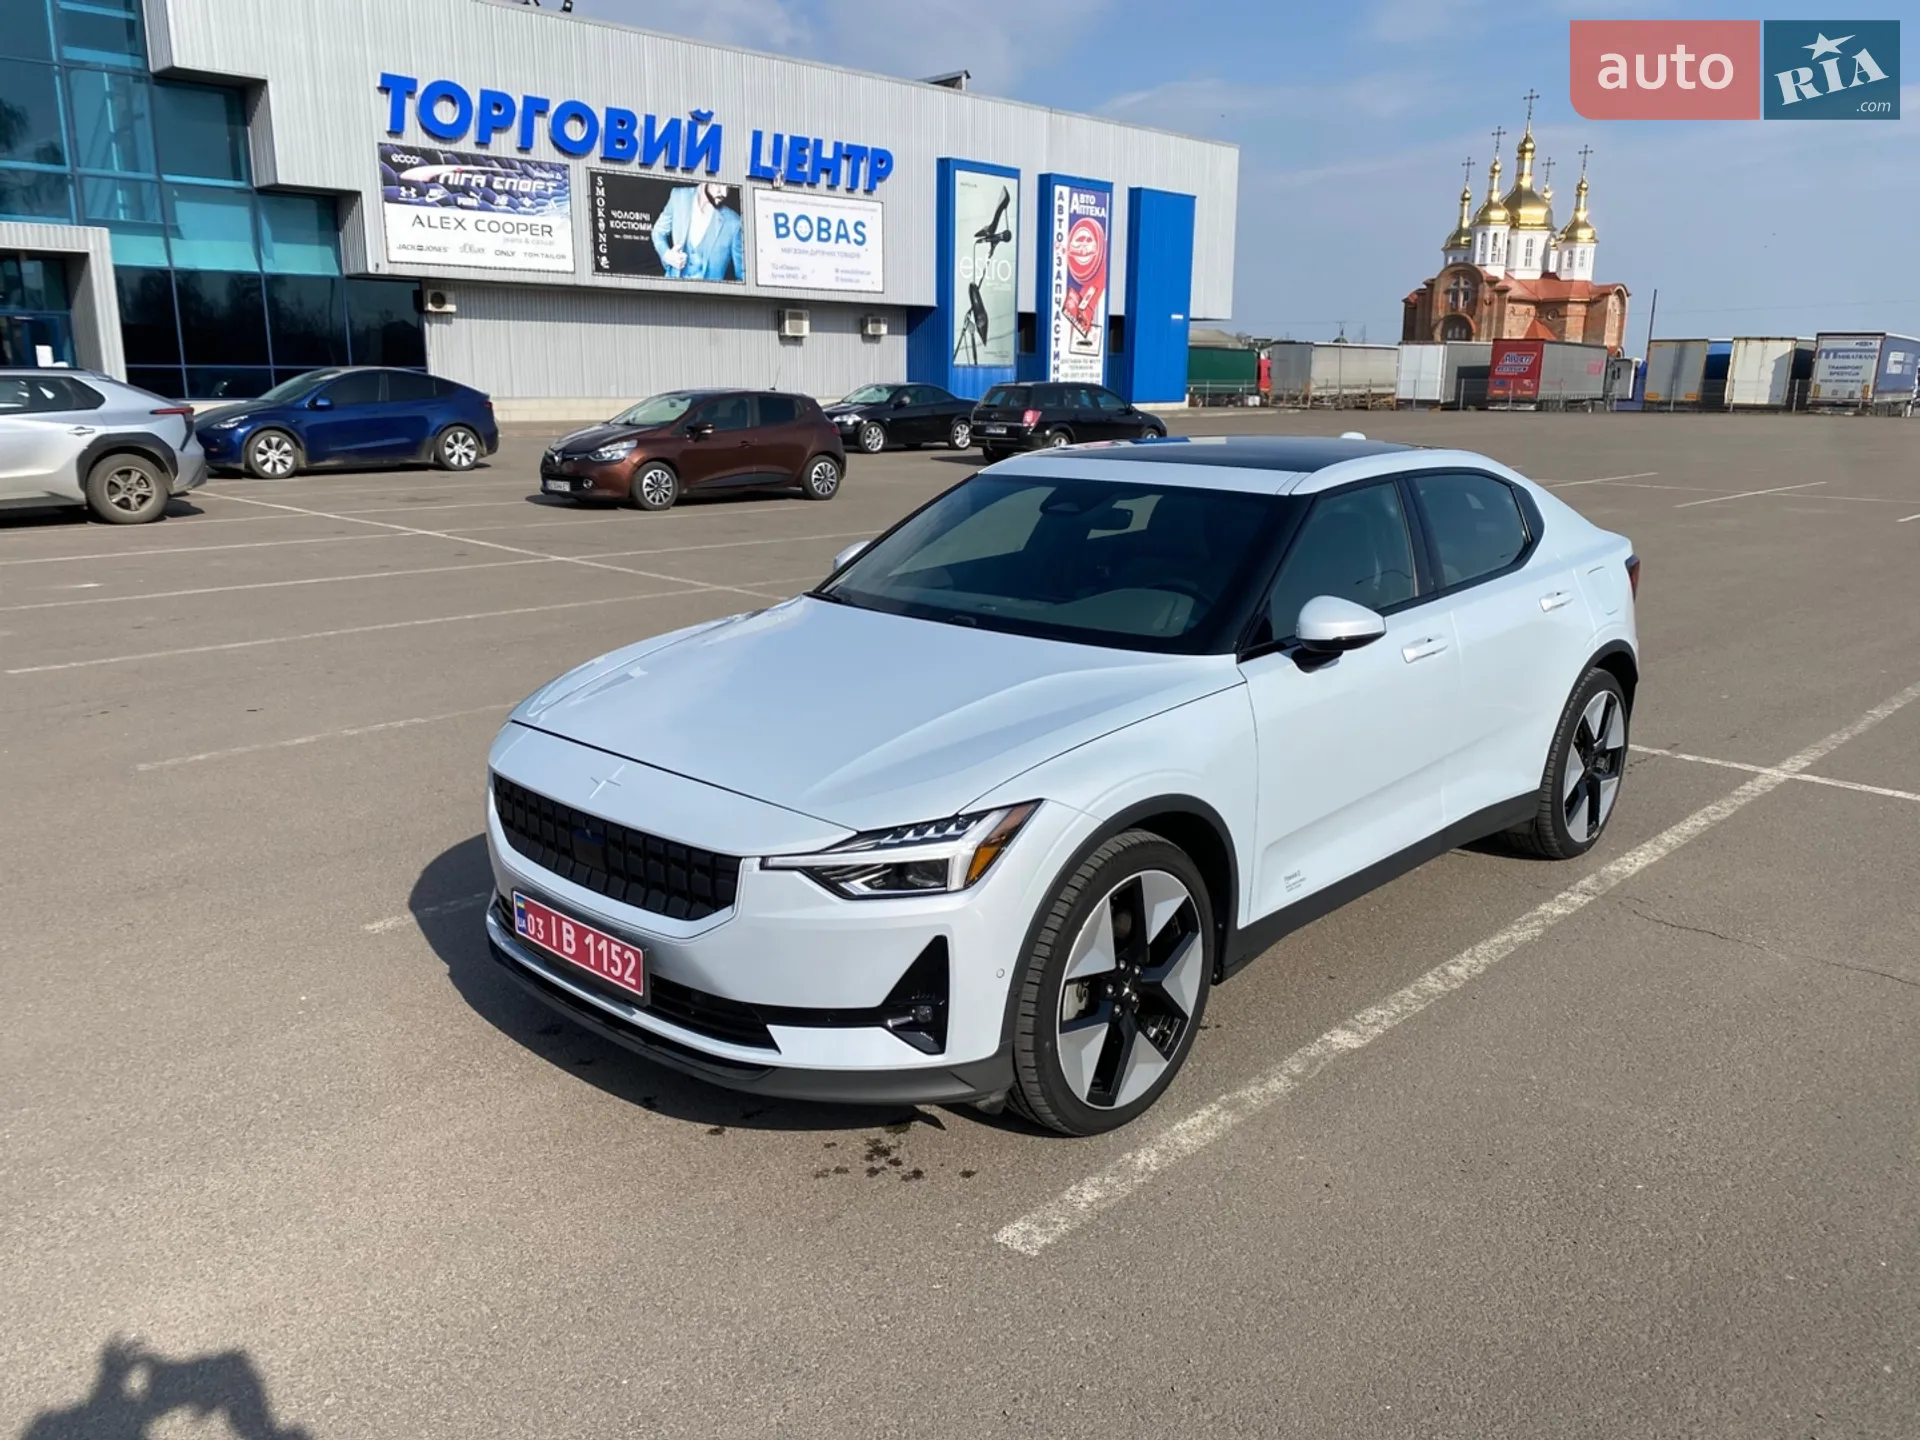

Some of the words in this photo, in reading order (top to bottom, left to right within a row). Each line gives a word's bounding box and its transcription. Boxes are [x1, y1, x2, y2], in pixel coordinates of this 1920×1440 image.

[378, 72, 722, 174] ТОРГОВИЙ
[747, 129, 894, 193] ЦЕНТР
[391, 153, 419, 165] ecco
[412, 214, 467, 232] ALEX
[474, 219, 554, 238] COOPER
[609, 219, 653, 232] КОСТЮМИ
[610, 209, 651, 221] ЧОЛОВІЧІ
[773, 212, 867, 246] BOBAS
[494, 249, 516, 257] ONLY
[959, 256, 1012, 282] estro
[527, 913, 545, 940] 03
[584, 933, 636, 986] 1152
